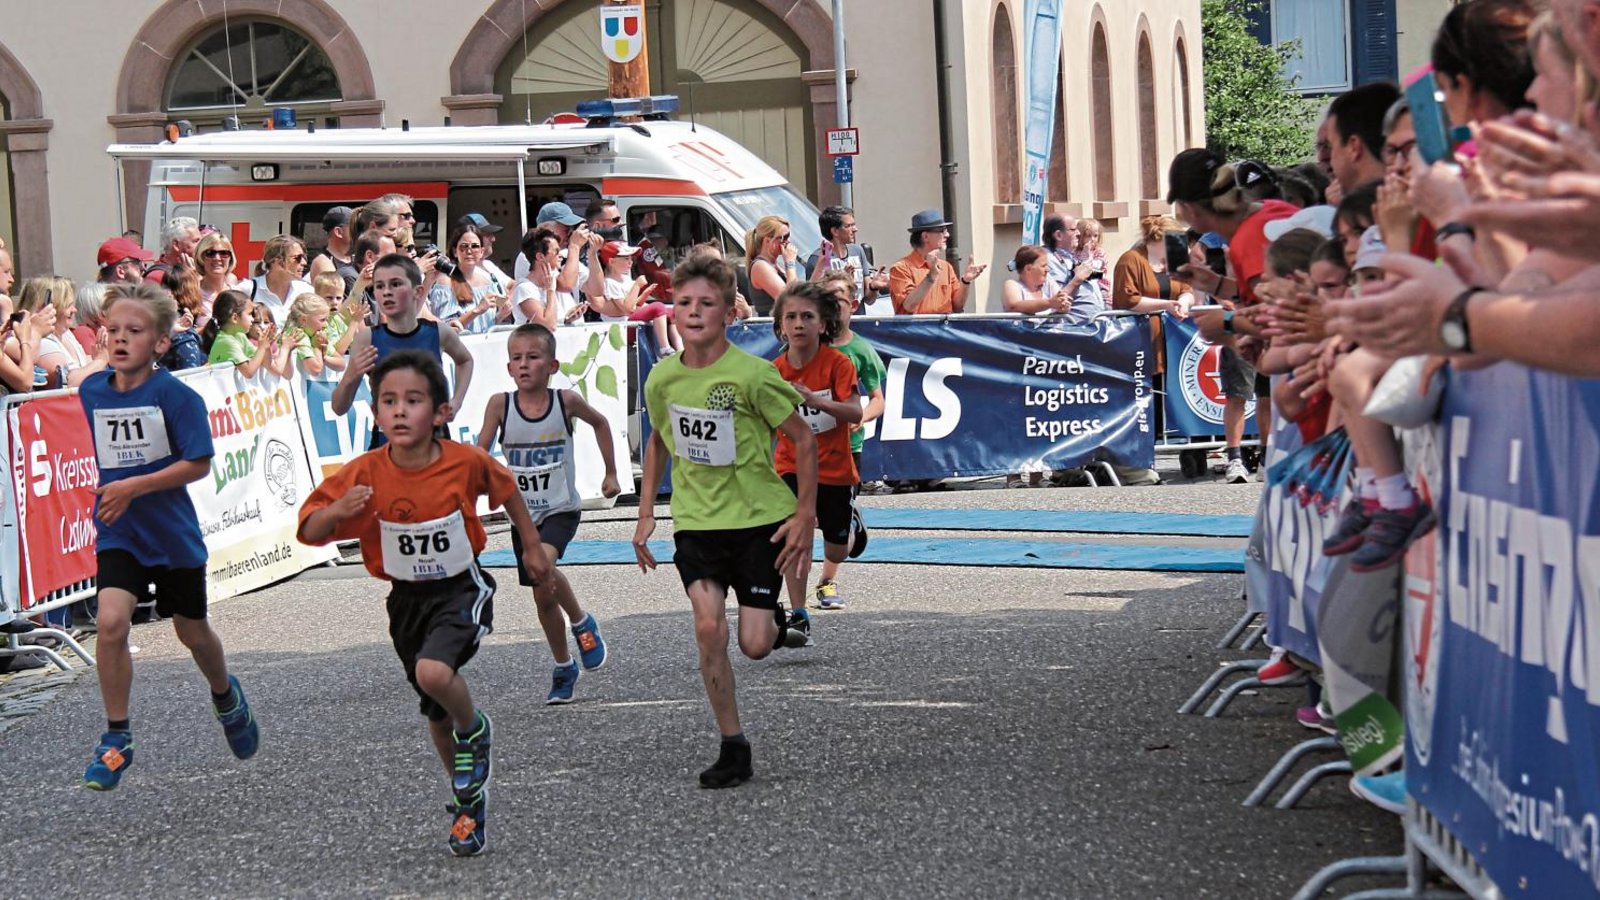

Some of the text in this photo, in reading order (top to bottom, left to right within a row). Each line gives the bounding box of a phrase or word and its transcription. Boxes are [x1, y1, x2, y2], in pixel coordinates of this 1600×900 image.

[1023, 355, 1084, 375] Parcel
[1024, 383, 1109, 412] Logistics
[1195, 398, 1224, 418] ENSI
[107, 418, 144, 442] 711
[679, 416, 717, 441] 642
[1026, 416, 1102, 442] Express
[518, 473, 550, 492] 917
[398, 530, 450, 556] 876
